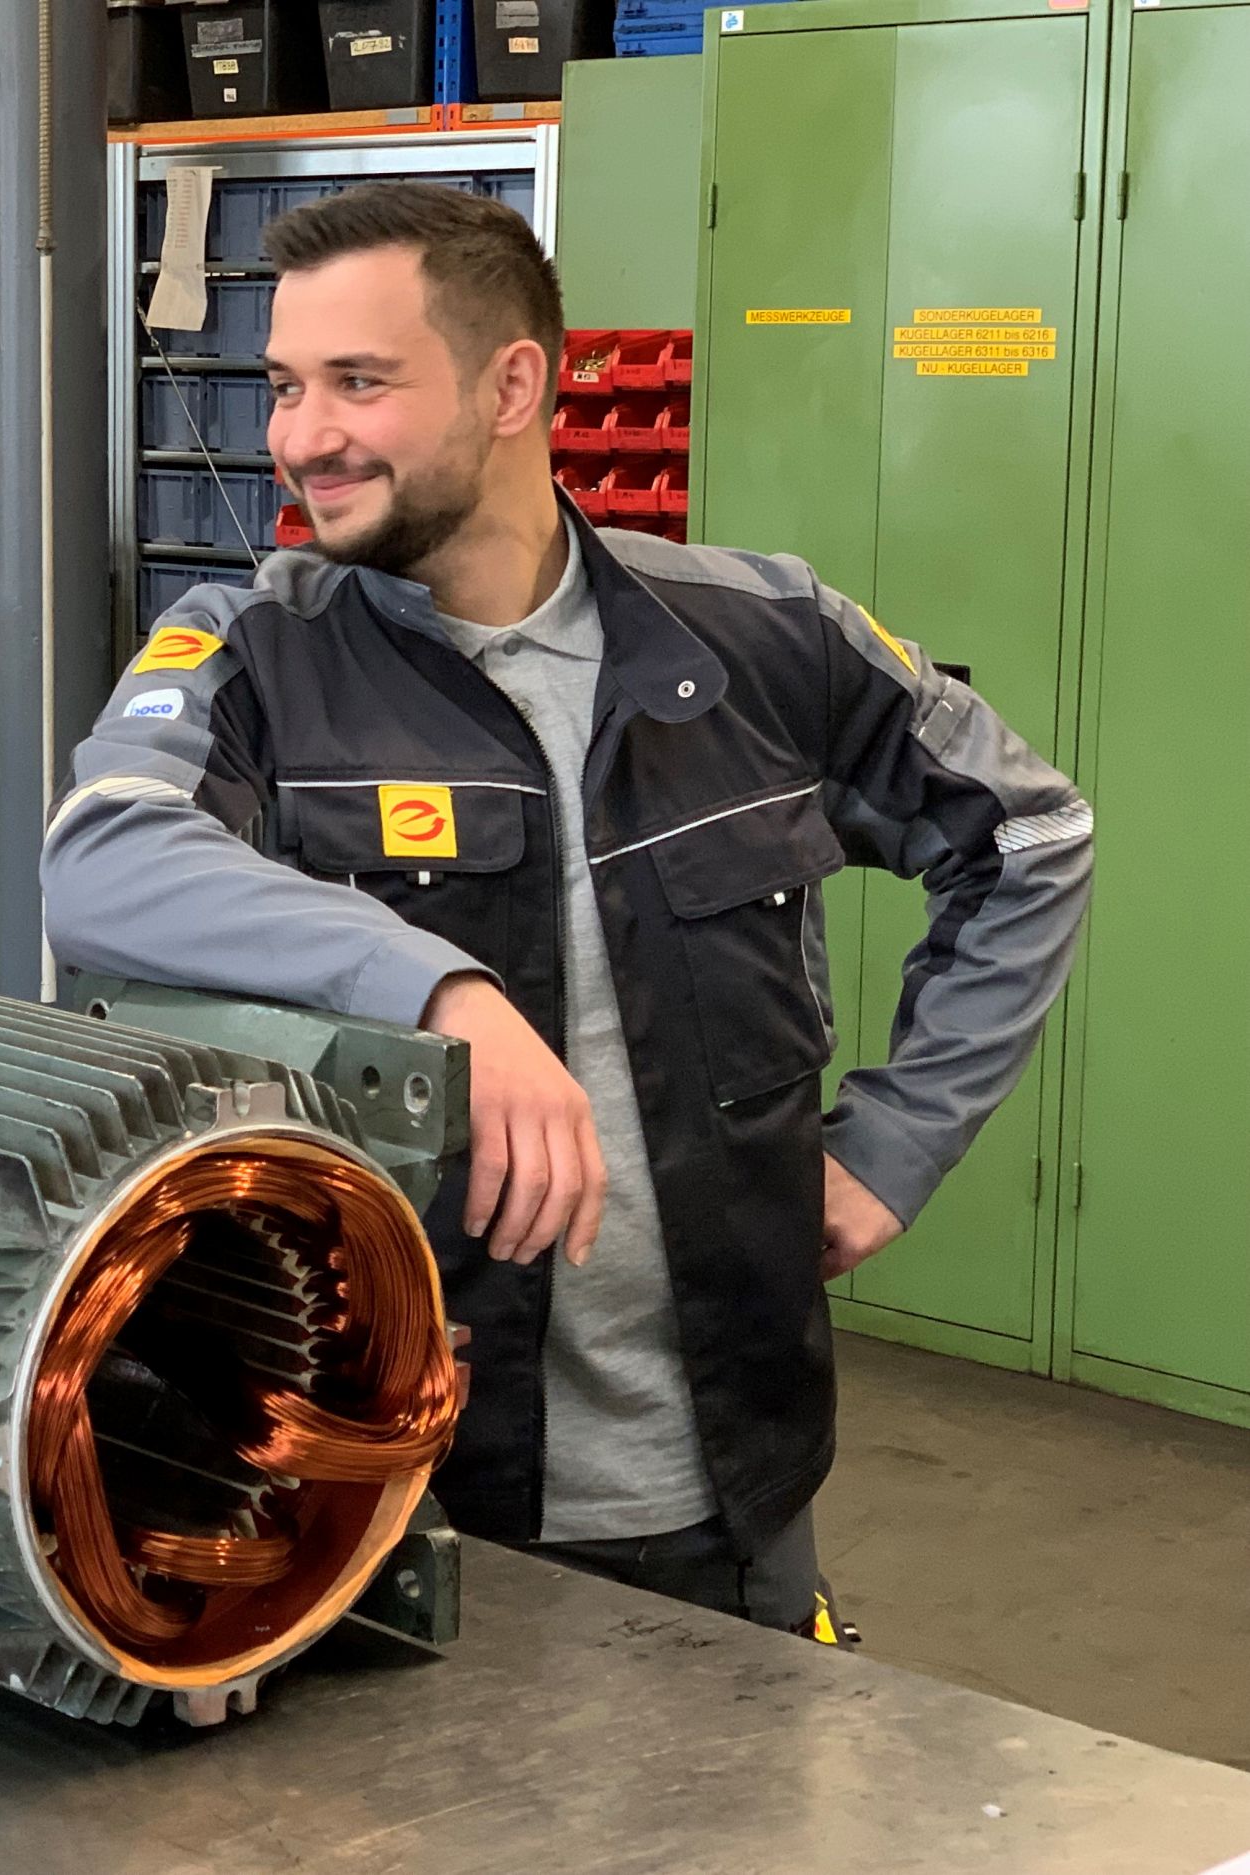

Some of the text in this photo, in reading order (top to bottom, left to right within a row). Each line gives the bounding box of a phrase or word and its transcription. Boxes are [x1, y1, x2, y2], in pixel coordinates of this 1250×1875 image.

[750, 310, 845, 322] MESSWERKZEUGE
[919, 310, 1035, 321] SONDERKUGELAGER
[900, 329, 1049, 340] KUGELLAGER 6211 bis 6216
[900, 346, 1049, 357] KUGELLAGER 6311 bis 6316
[921, 363, 938, 373] NU
[948, 363, 1022, 374] KUGELLAGER
